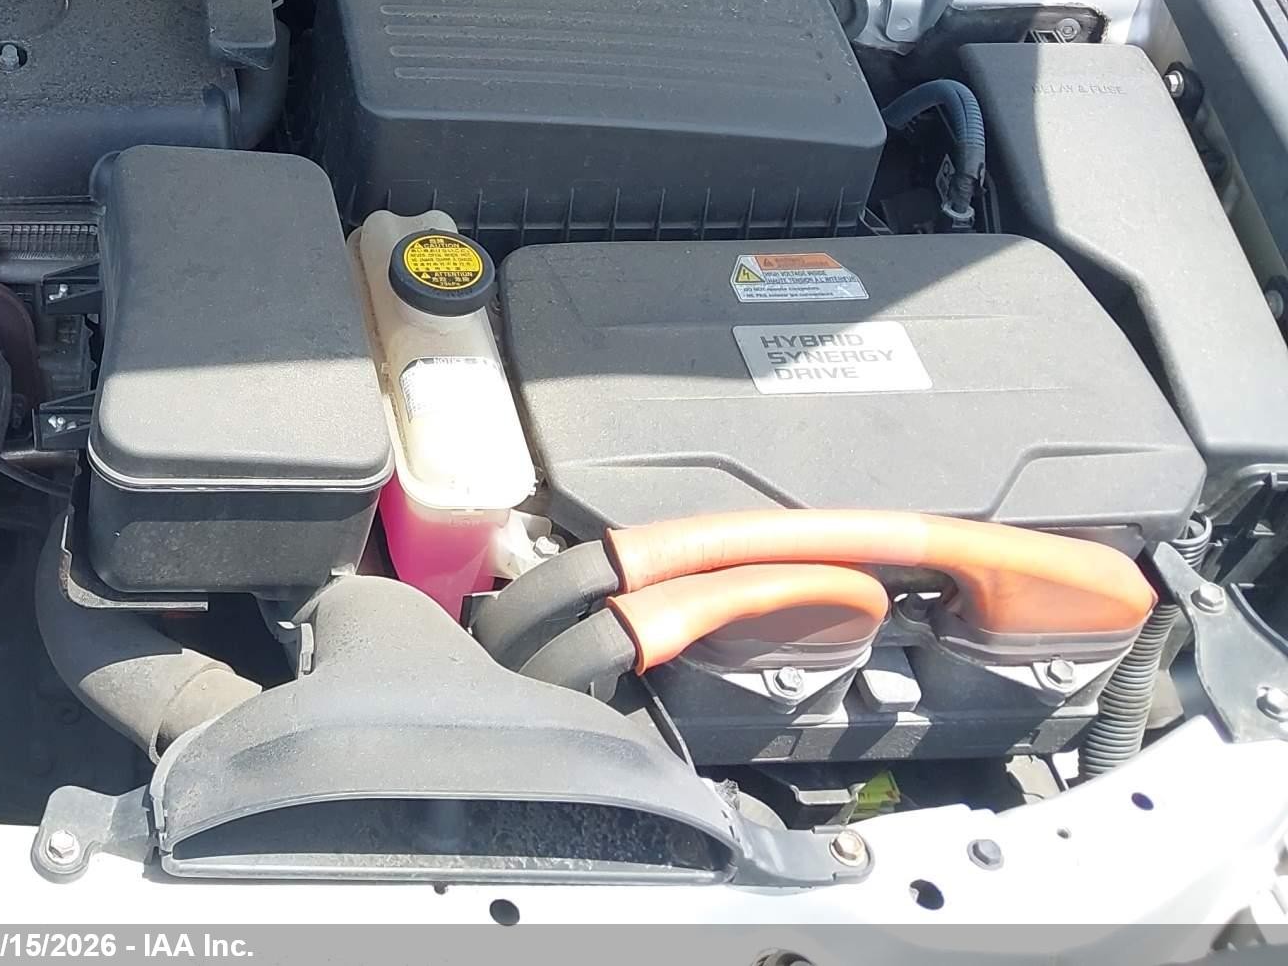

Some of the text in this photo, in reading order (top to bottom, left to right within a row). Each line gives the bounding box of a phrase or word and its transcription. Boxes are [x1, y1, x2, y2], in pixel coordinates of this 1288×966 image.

[760, 334, 864, 348] HYBRID
[767, 349, 893, 365] SYNERGY
[774, 366, 860, 380] DRIVE
